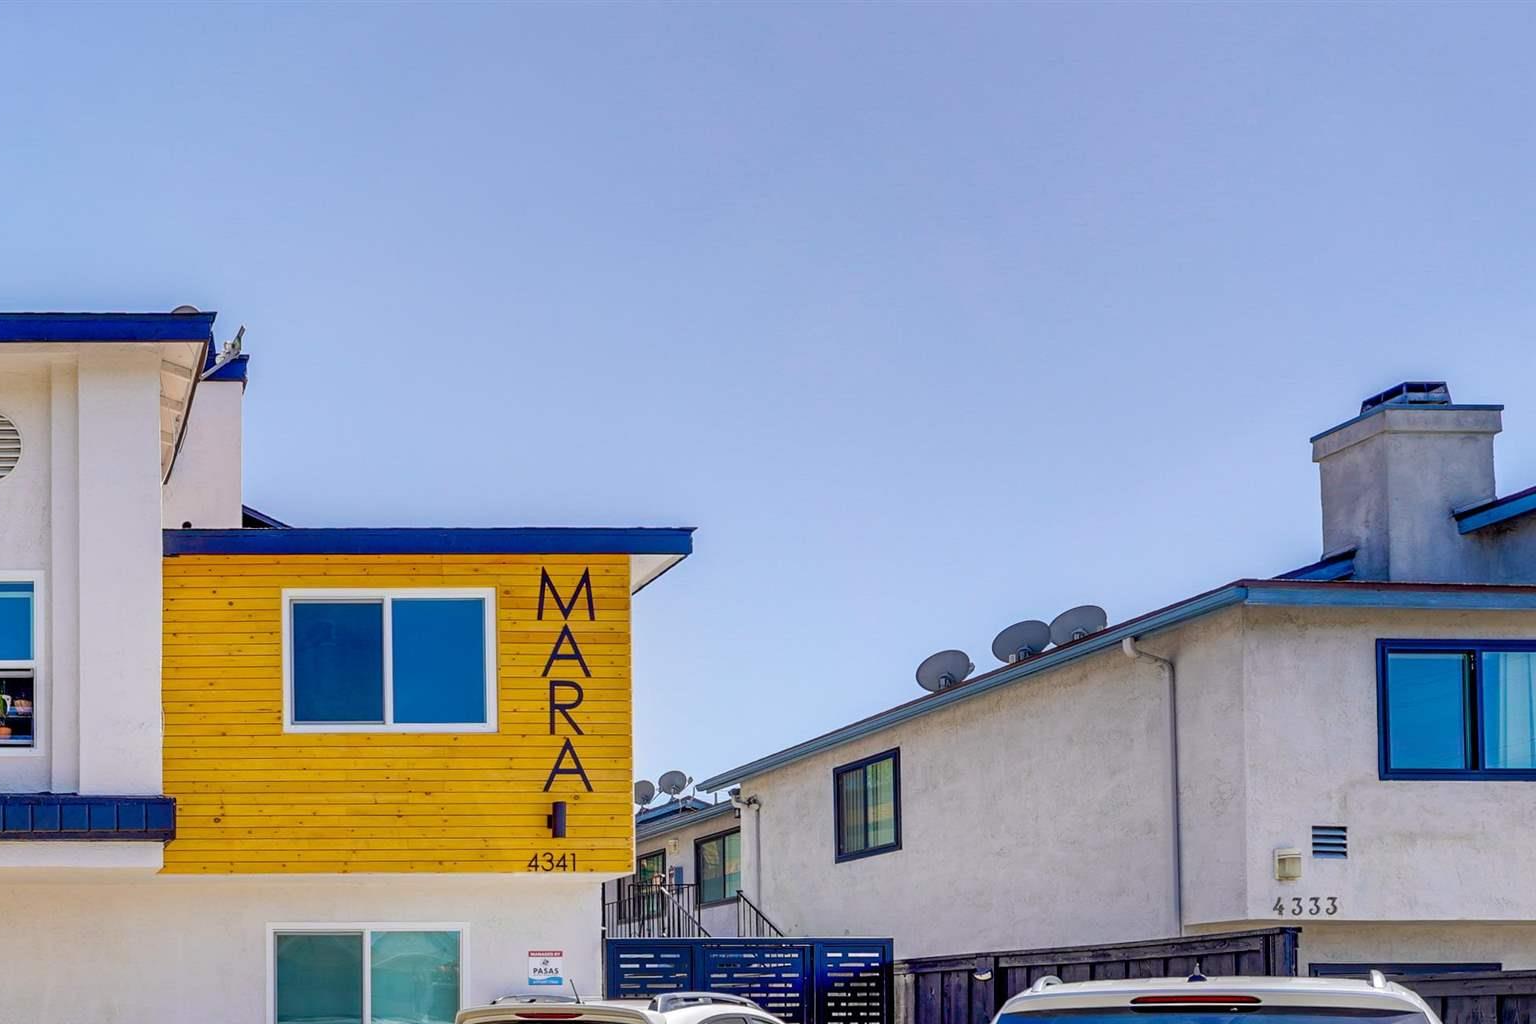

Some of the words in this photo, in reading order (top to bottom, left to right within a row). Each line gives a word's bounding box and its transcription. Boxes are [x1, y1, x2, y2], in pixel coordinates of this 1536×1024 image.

[537, 566, 595, 793] MARA
[527, 852, 576, 872] 4341
[1272, 896, 1338, 916] 4333
[532, 967, 560, 975] PASAS
